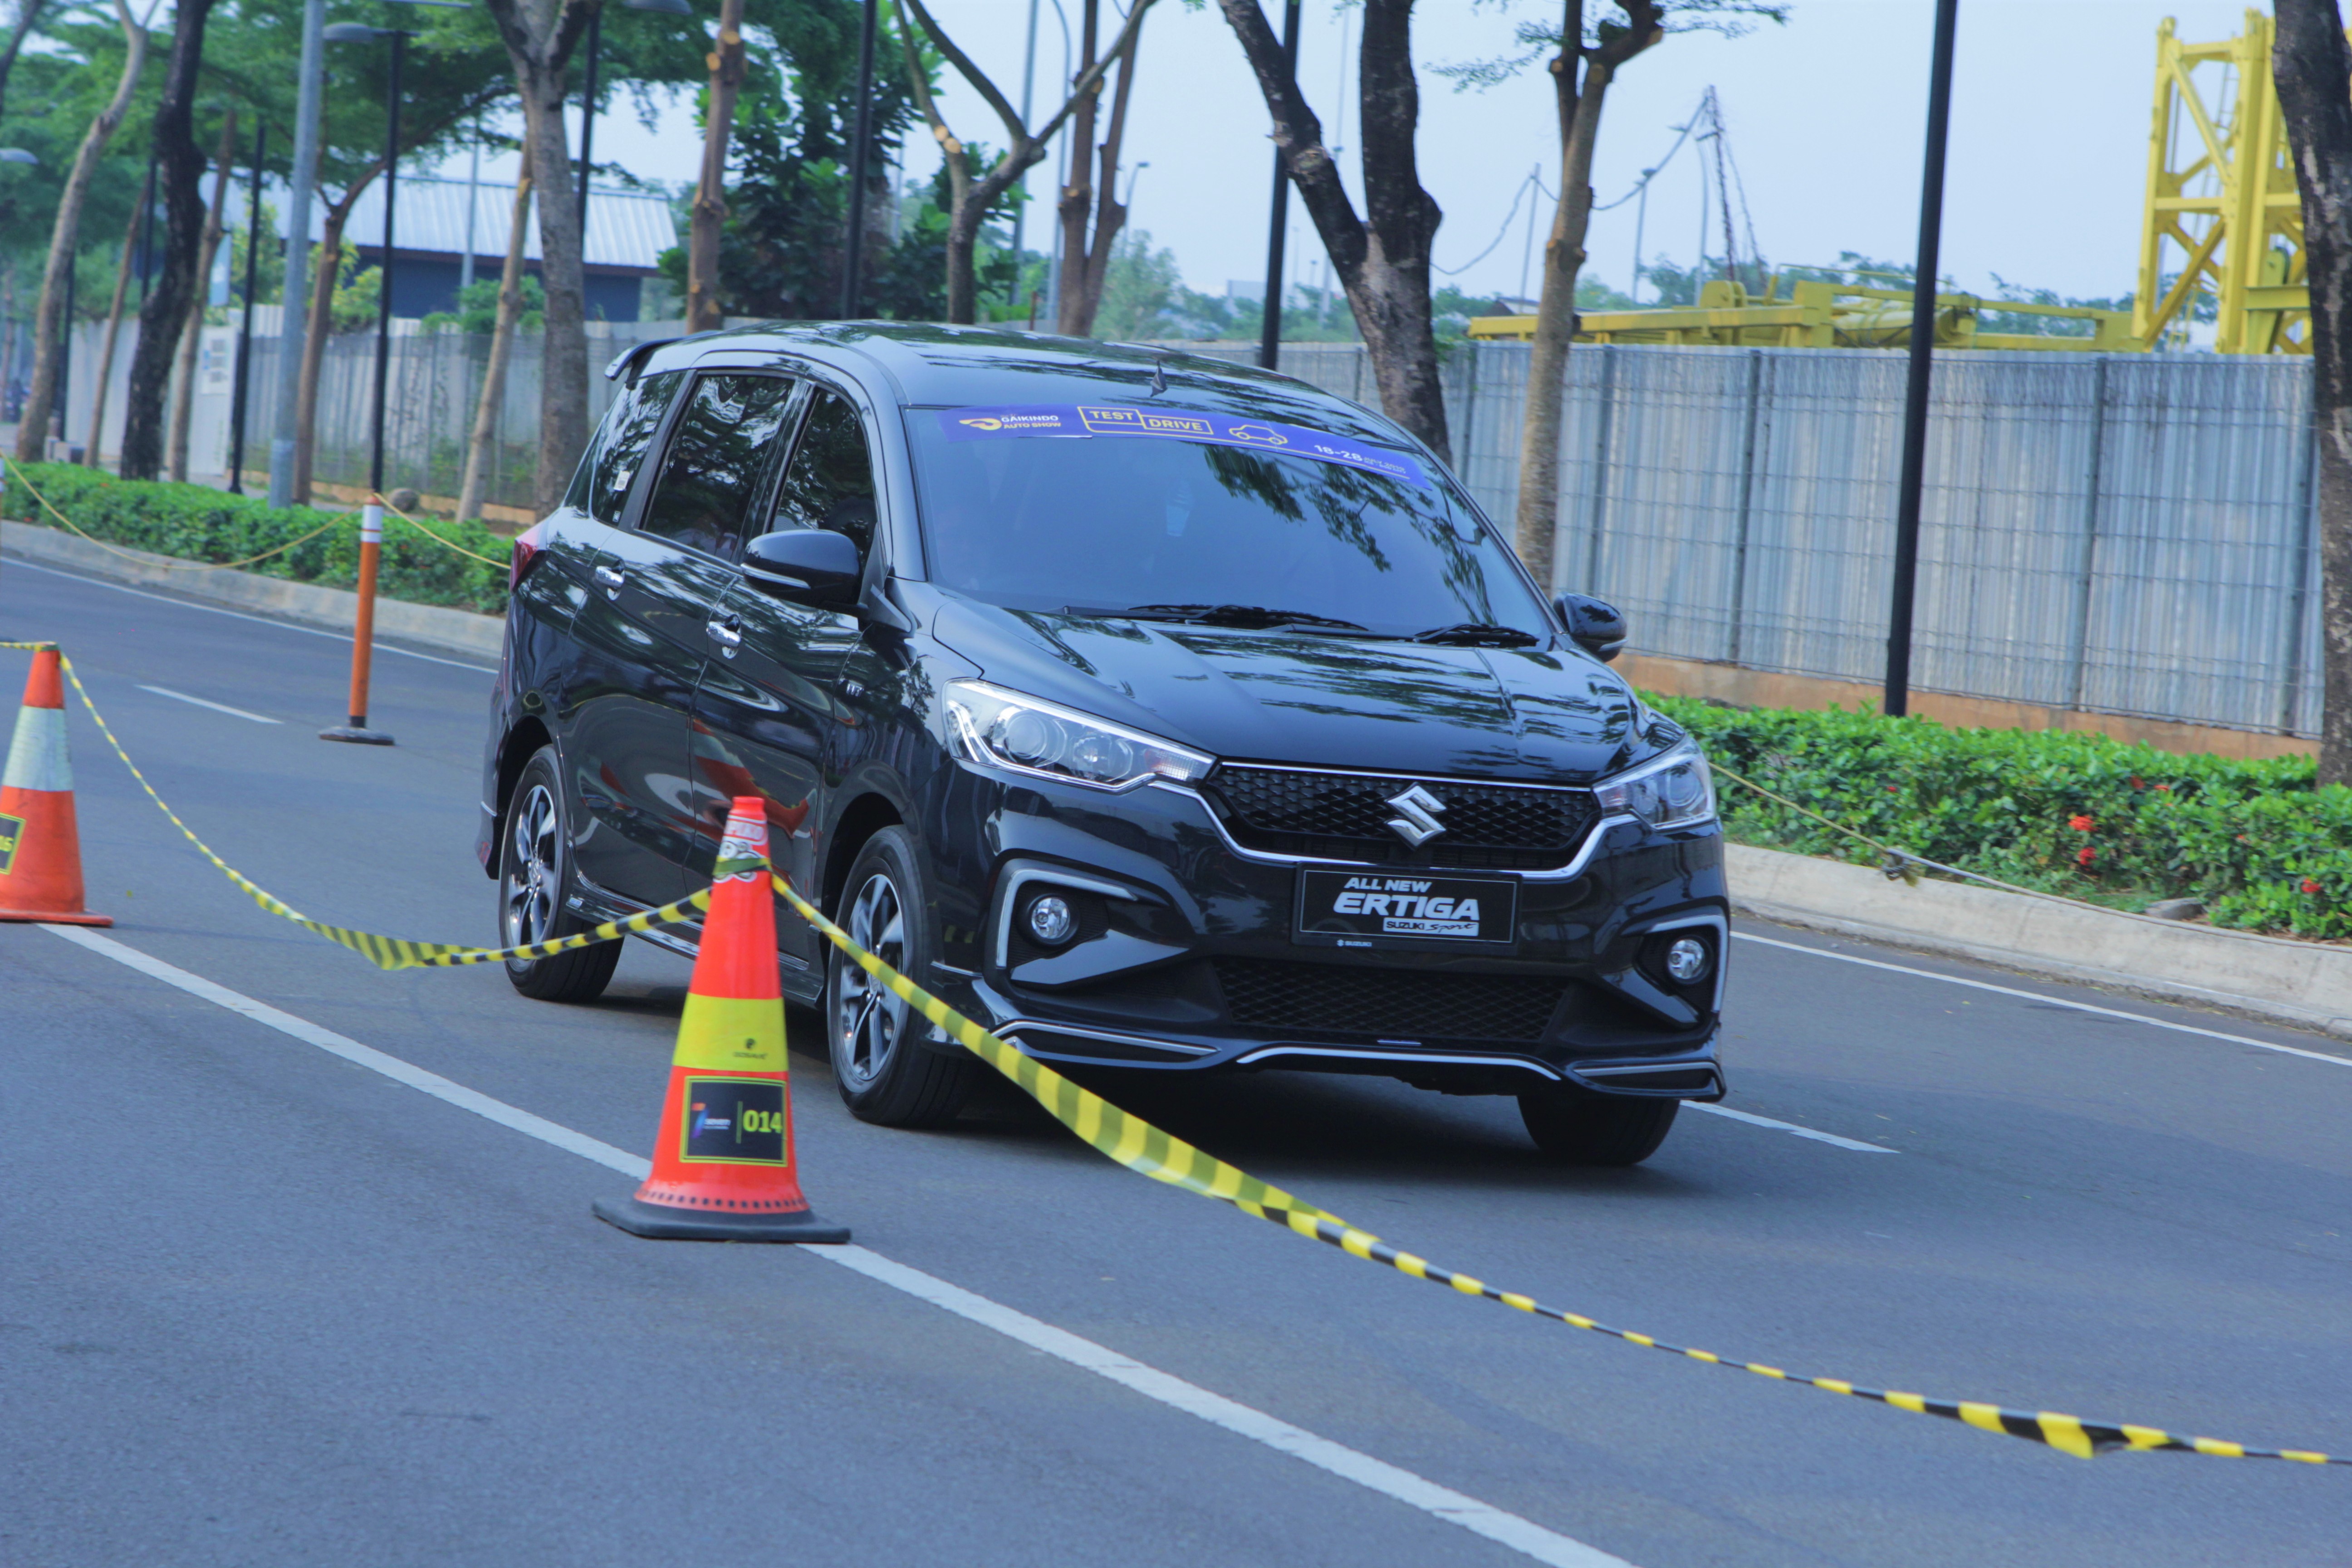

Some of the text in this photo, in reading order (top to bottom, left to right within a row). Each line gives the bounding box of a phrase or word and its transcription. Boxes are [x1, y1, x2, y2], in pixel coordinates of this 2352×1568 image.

[1090, 411, 1203, 431] TEST DRIVE
[1344, 877, 1432, 893] ALL NEW
[1333, 892, 1480, 921] ERTIGA
[1386, 921, 1425, 930] SUZUKI
[743, 1109, 784, 1134] 014
